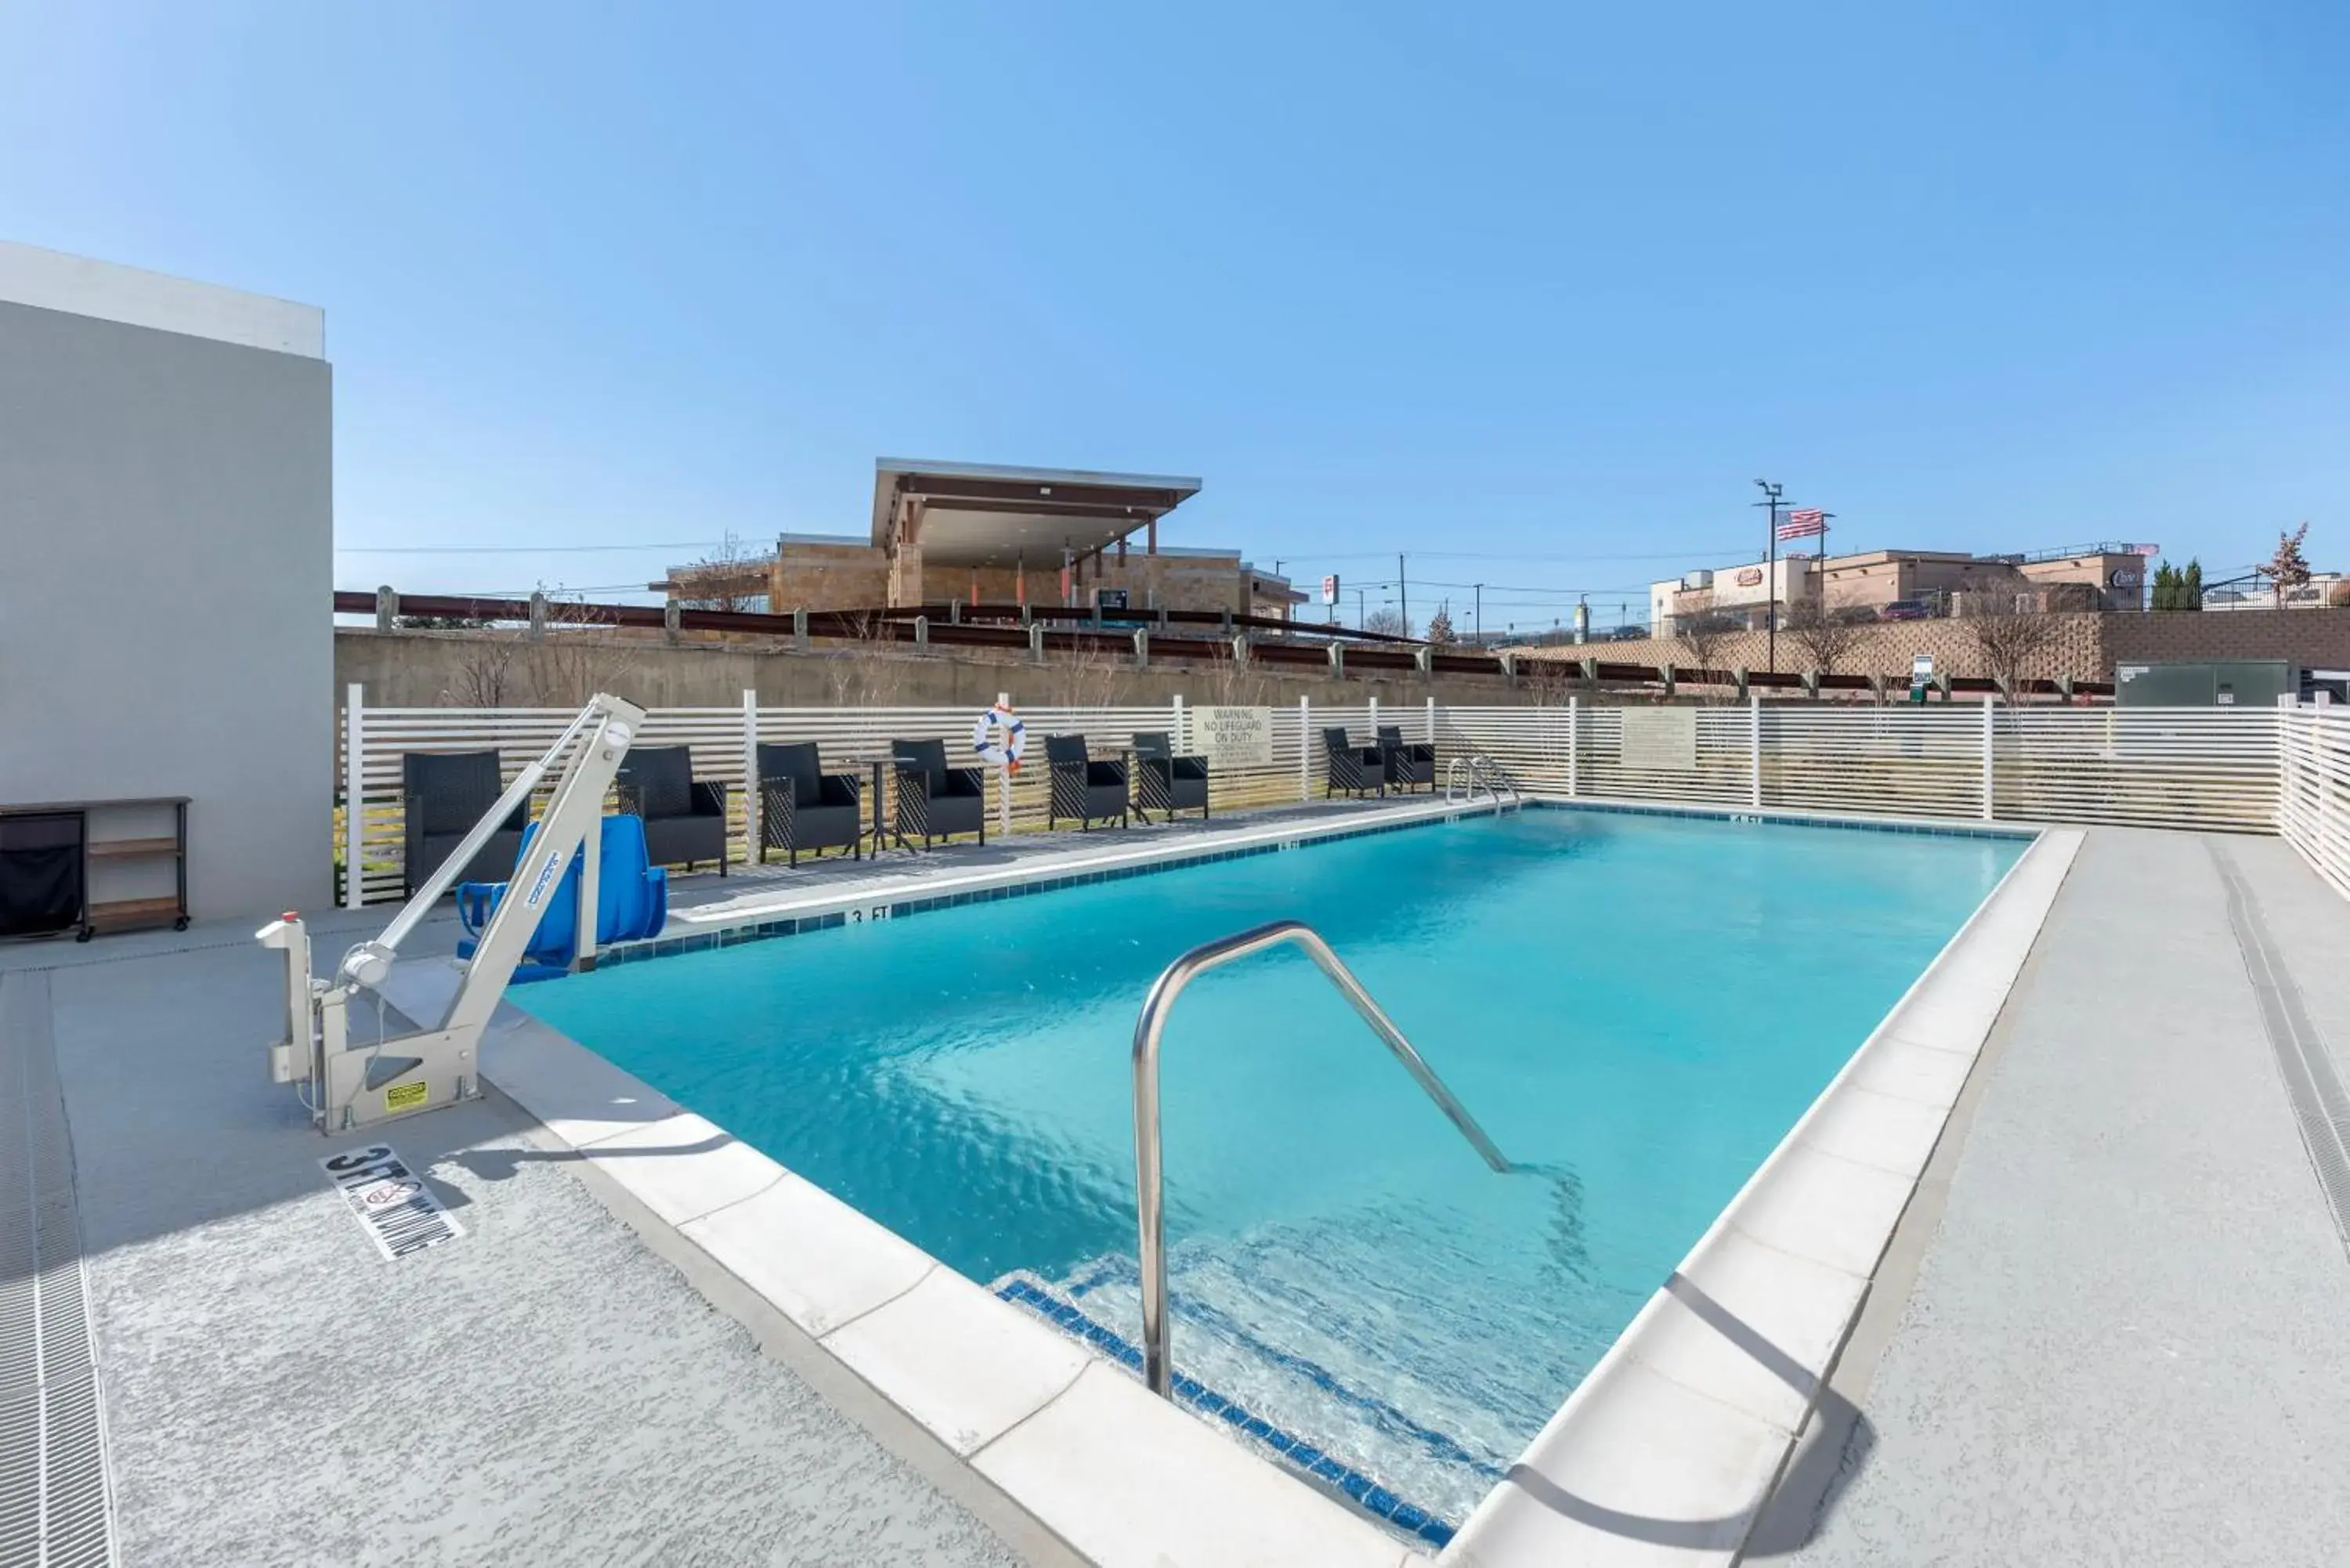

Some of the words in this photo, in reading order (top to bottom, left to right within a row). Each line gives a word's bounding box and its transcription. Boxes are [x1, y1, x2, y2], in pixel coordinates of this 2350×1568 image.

[1213, 708, 1254, 720] WARNING
[1204, 721, 1217, 732] NO
[1220, 719, 1262, 732] LIFEGUARD
[1215, 732, 1227, 742] ON
[1231, 732, 1253, 742] DUTY
[851, 909, 862, 923] 3
[872, 905, 889, 922] FT
[326, 1147, 392, 1171] 3
[336, 1160, 410, 1190] FT
[367, 1196, 432, 1224] NO
[376, 1207, 456, 1258] DIVING
